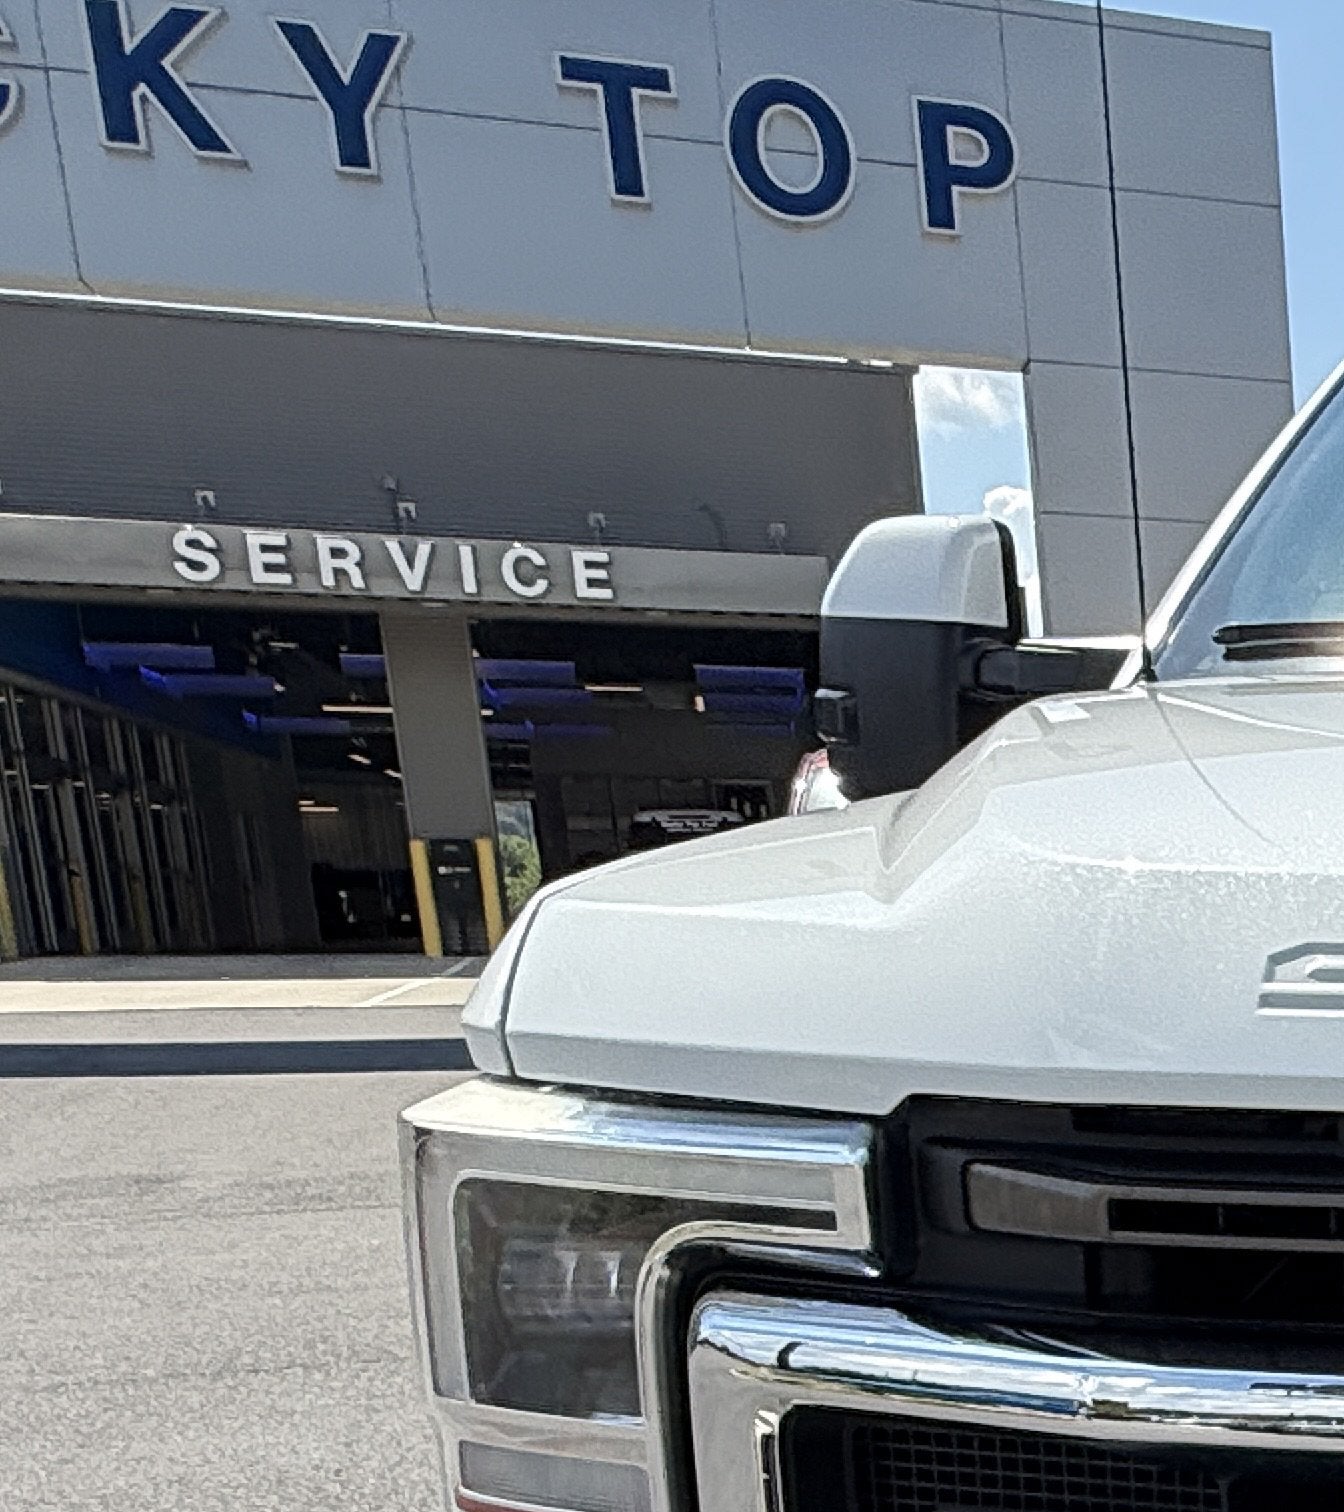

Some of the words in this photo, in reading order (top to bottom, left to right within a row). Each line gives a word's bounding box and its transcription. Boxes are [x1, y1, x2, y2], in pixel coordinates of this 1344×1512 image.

[0, 0, 408, 175] KY
[553, 50, 1020, 236] TOP
[172, 527, 616, 602] SERVICE
